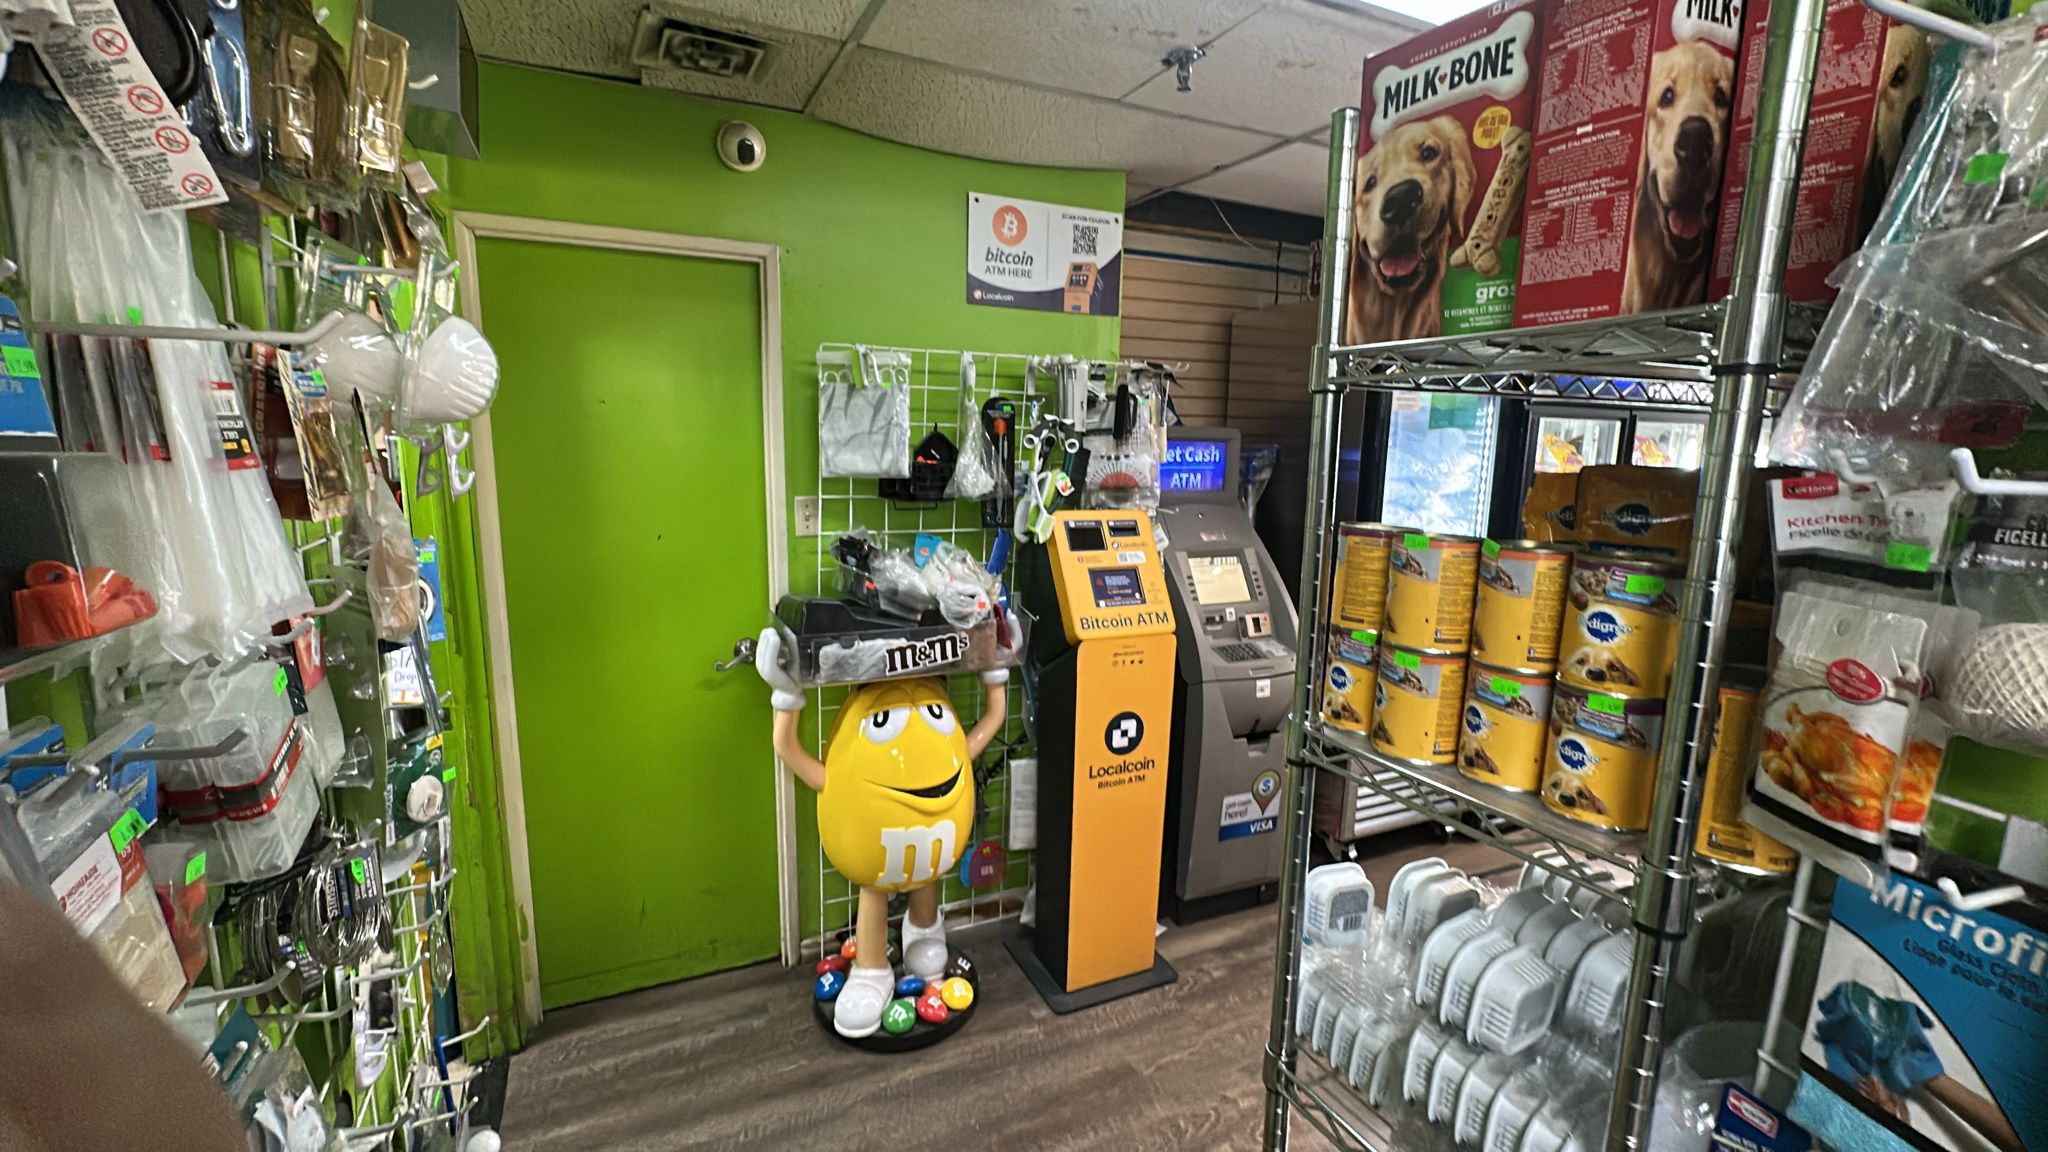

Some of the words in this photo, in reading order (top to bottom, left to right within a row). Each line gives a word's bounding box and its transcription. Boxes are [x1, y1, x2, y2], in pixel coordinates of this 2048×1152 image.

[1382, 65, 1440, 120] MILK
[1448, 36, 1517, 91] BONE
[985, 246, 1034, 267] bitcoin
[985, 265, 1006, 277] ATM
[1007, 268, 1033, 279] HERE
[982, 291, 1015, 302] Localcoin
[1167, 446, 1182, 463] et
[1184, 445, 1221, 463] Cash
[1170, 472, 1202, 489] ATM
[1786, 512, 1863, 529] Kitchen
[1788, 526, 1840, 541] Ficelle
[1993, 527, 2048, 548] FICELL
[1080, 615, 1133, 630] Bitcoin
[1137, 611, 1169, 626] ATM
[1088, 757, 1156, 780] Localcoin
[1097, 778, 1126, 790] Bitcoin
[1127, 774, 1146, 784] ATM
[1250, 819, 1273, 833] VISA
[874, 819, 957, 885] m
[1870, 875, 2048, 977] Microfi
